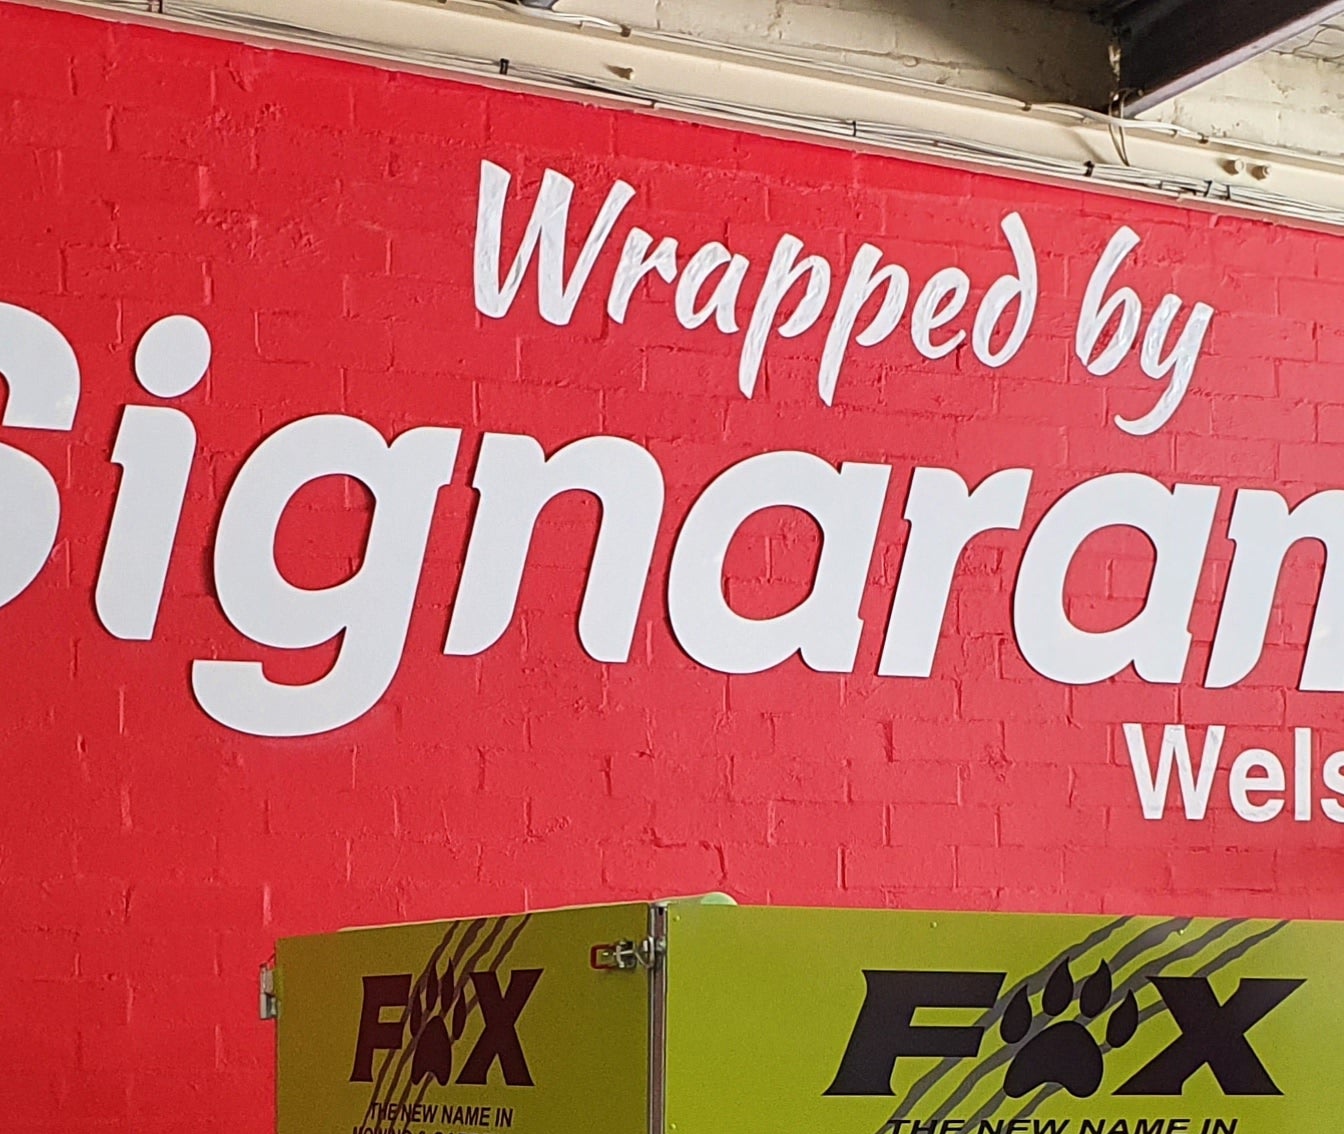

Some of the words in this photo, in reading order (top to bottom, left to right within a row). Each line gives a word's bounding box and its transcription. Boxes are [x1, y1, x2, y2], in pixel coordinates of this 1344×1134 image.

[471, 159, 1037, 403] Wrapped
[1076, 225, 1214, 437] by
[370, 1102, 398, 1122] THE
[402, 1104, 439, 1124] NEW
[442, 1105, 490, 1127] NAME
[496, 1108, 513, 1127] IN
